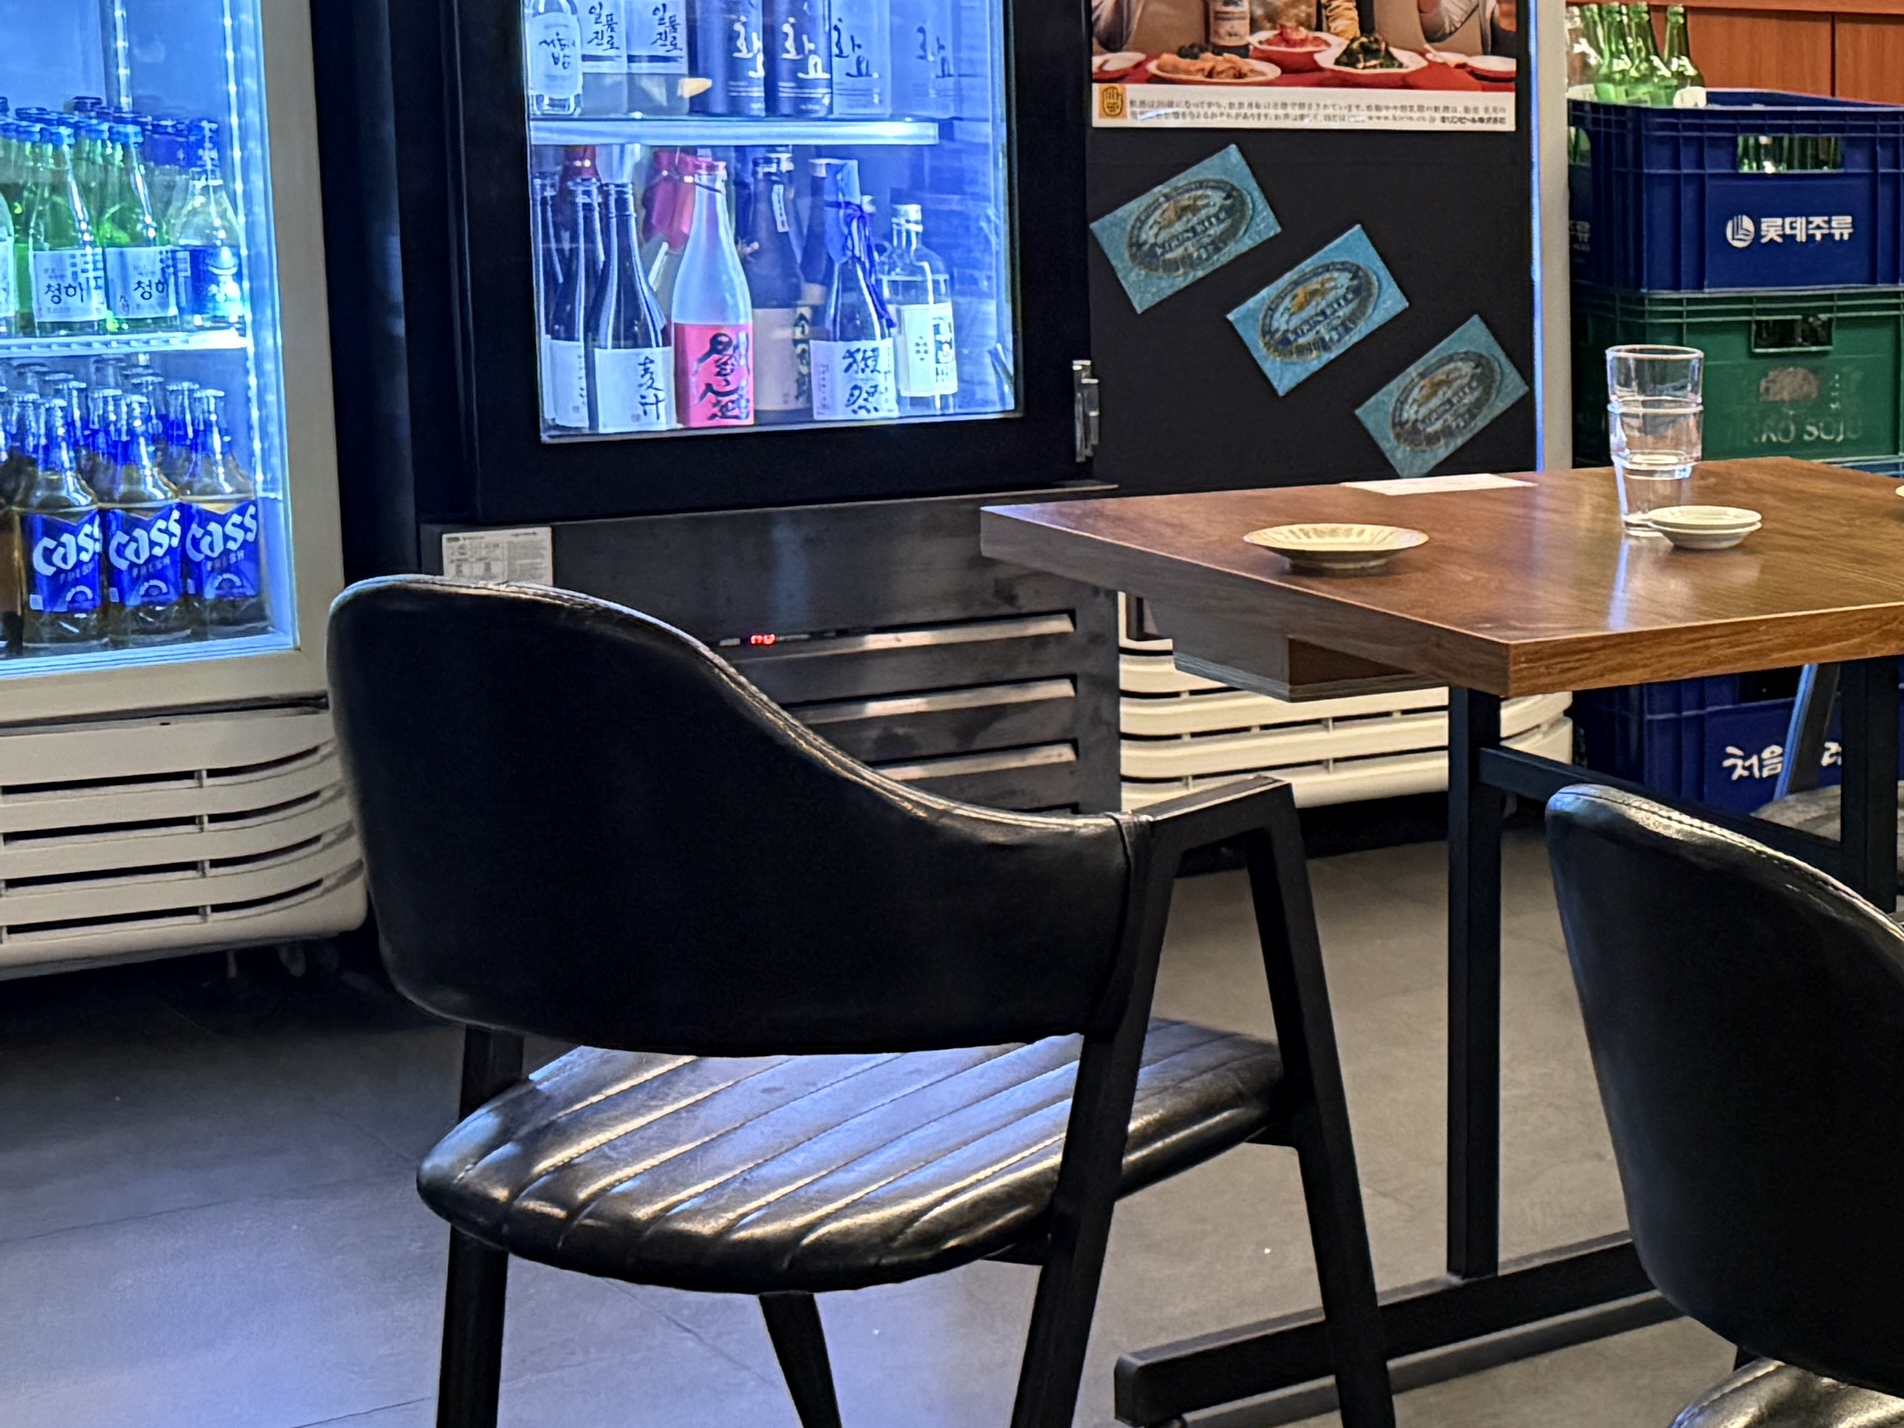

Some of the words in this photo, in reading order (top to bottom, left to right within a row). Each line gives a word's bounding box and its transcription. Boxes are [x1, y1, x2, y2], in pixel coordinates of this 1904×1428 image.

[587, 31, 620, 52] 진로
[1760, 215, 1854, 243] 롯데주류
[44, 282, 84, 304] 청하
[109, 508, 182, 570] CASS
[186, 504, 257, 562] CASS
